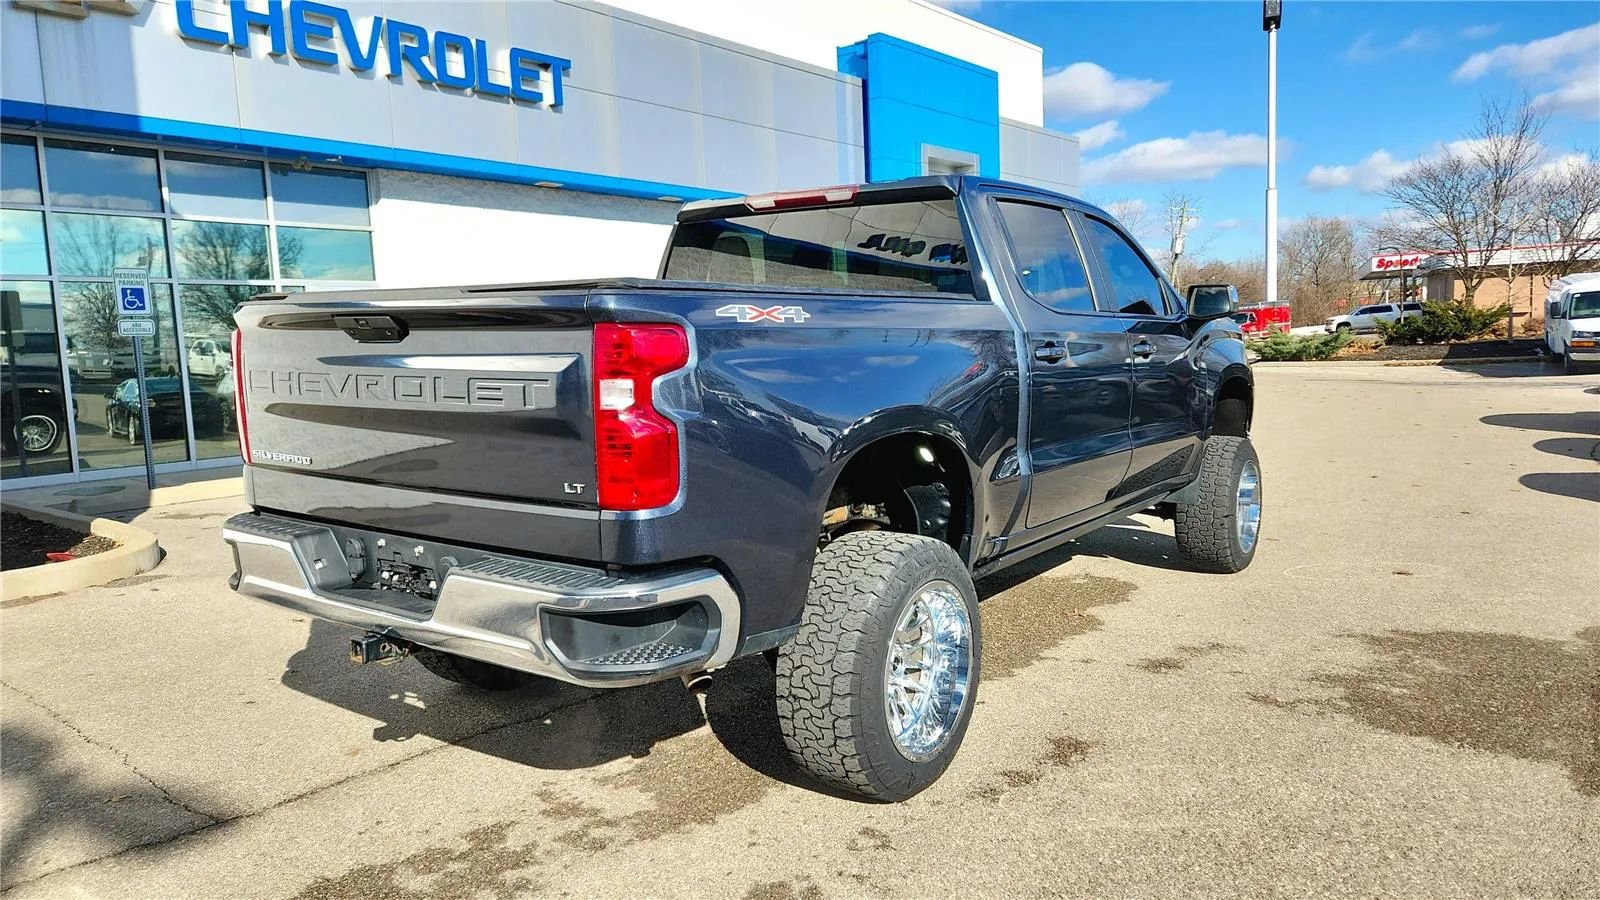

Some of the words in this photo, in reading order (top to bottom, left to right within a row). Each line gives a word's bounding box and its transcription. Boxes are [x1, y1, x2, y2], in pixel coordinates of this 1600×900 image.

[176, 0, 572, 107] CHEVROLET
[1376, 256, 1420, 270] Speed
[248, 370, 551, 408] CHEVROLET
[252, 449, 312, 465] SILVERADO
[563, 482, 586, 494] LT
